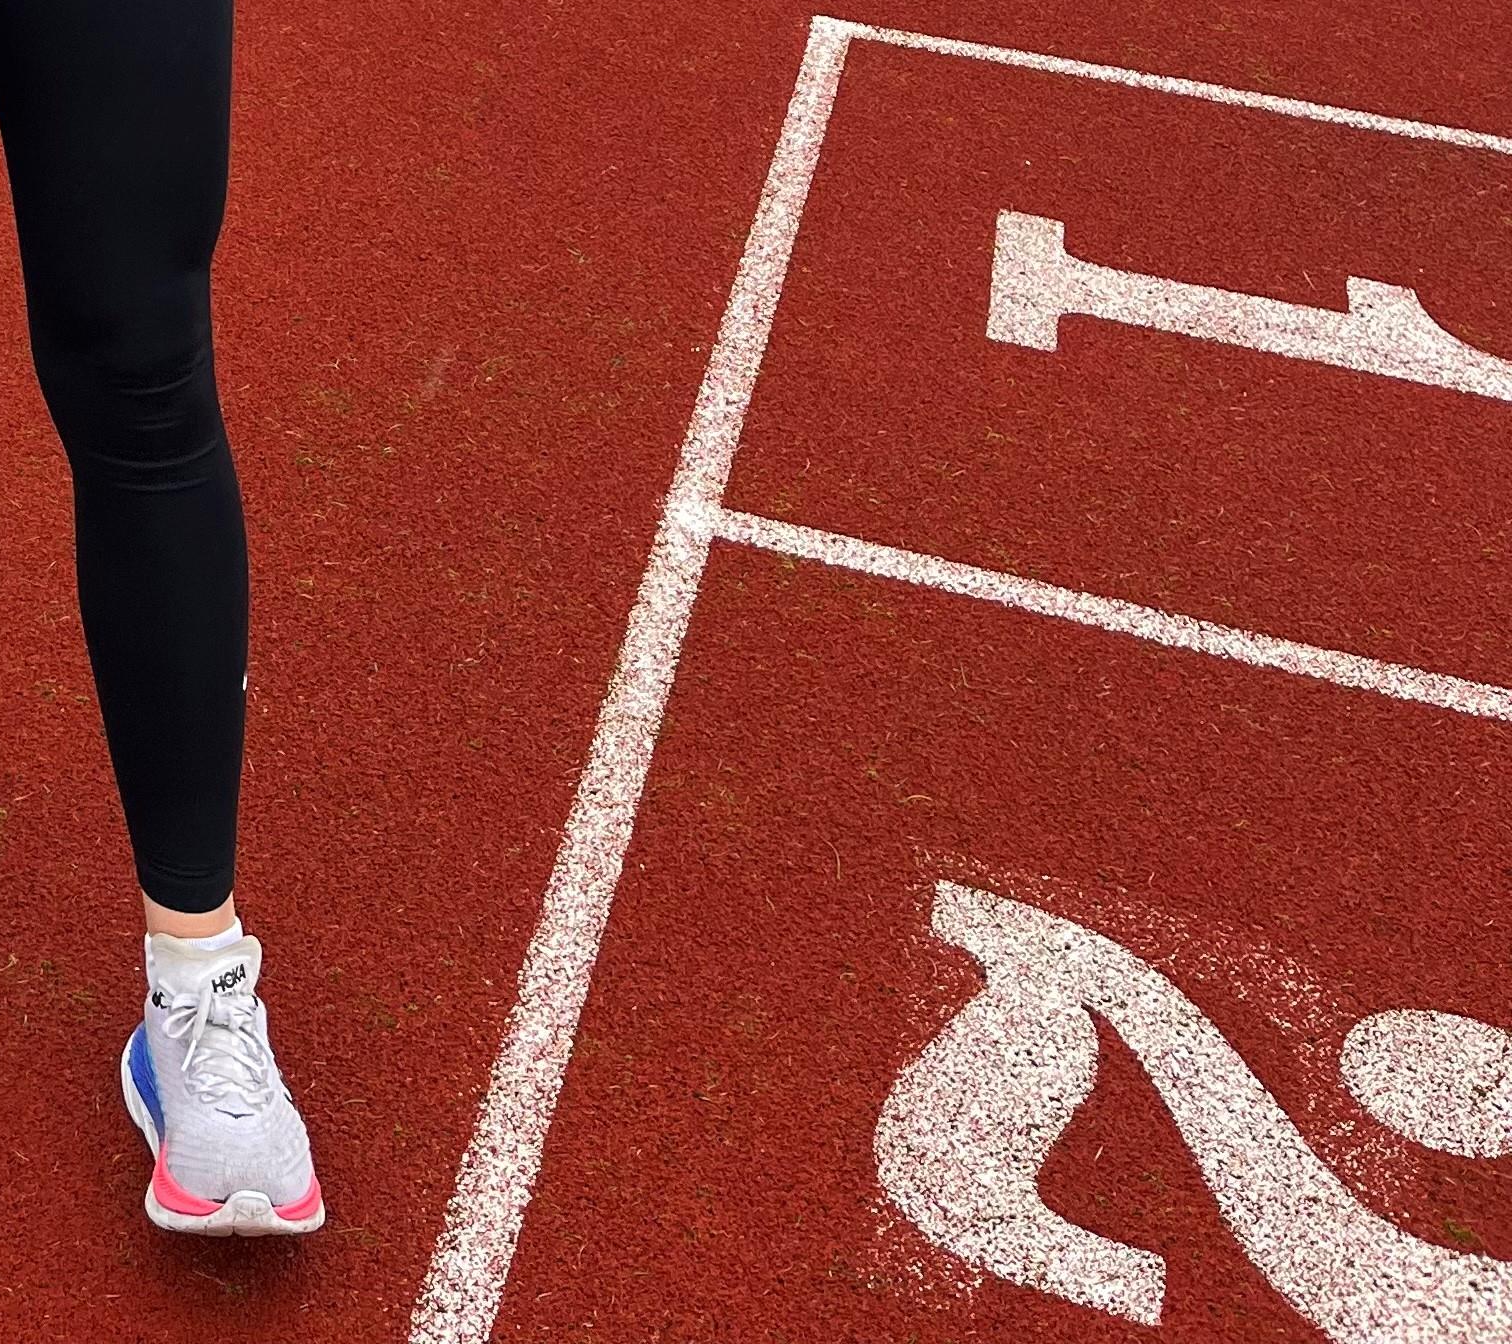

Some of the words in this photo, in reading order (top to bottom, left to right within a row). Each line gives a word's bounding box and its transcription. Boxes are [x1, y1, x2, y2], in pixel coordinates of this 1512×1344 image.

[986, 209, 1512, 402] 1
[212, 964, 246, 992] HOKA
[873, 880, 1512, 1344] 2
